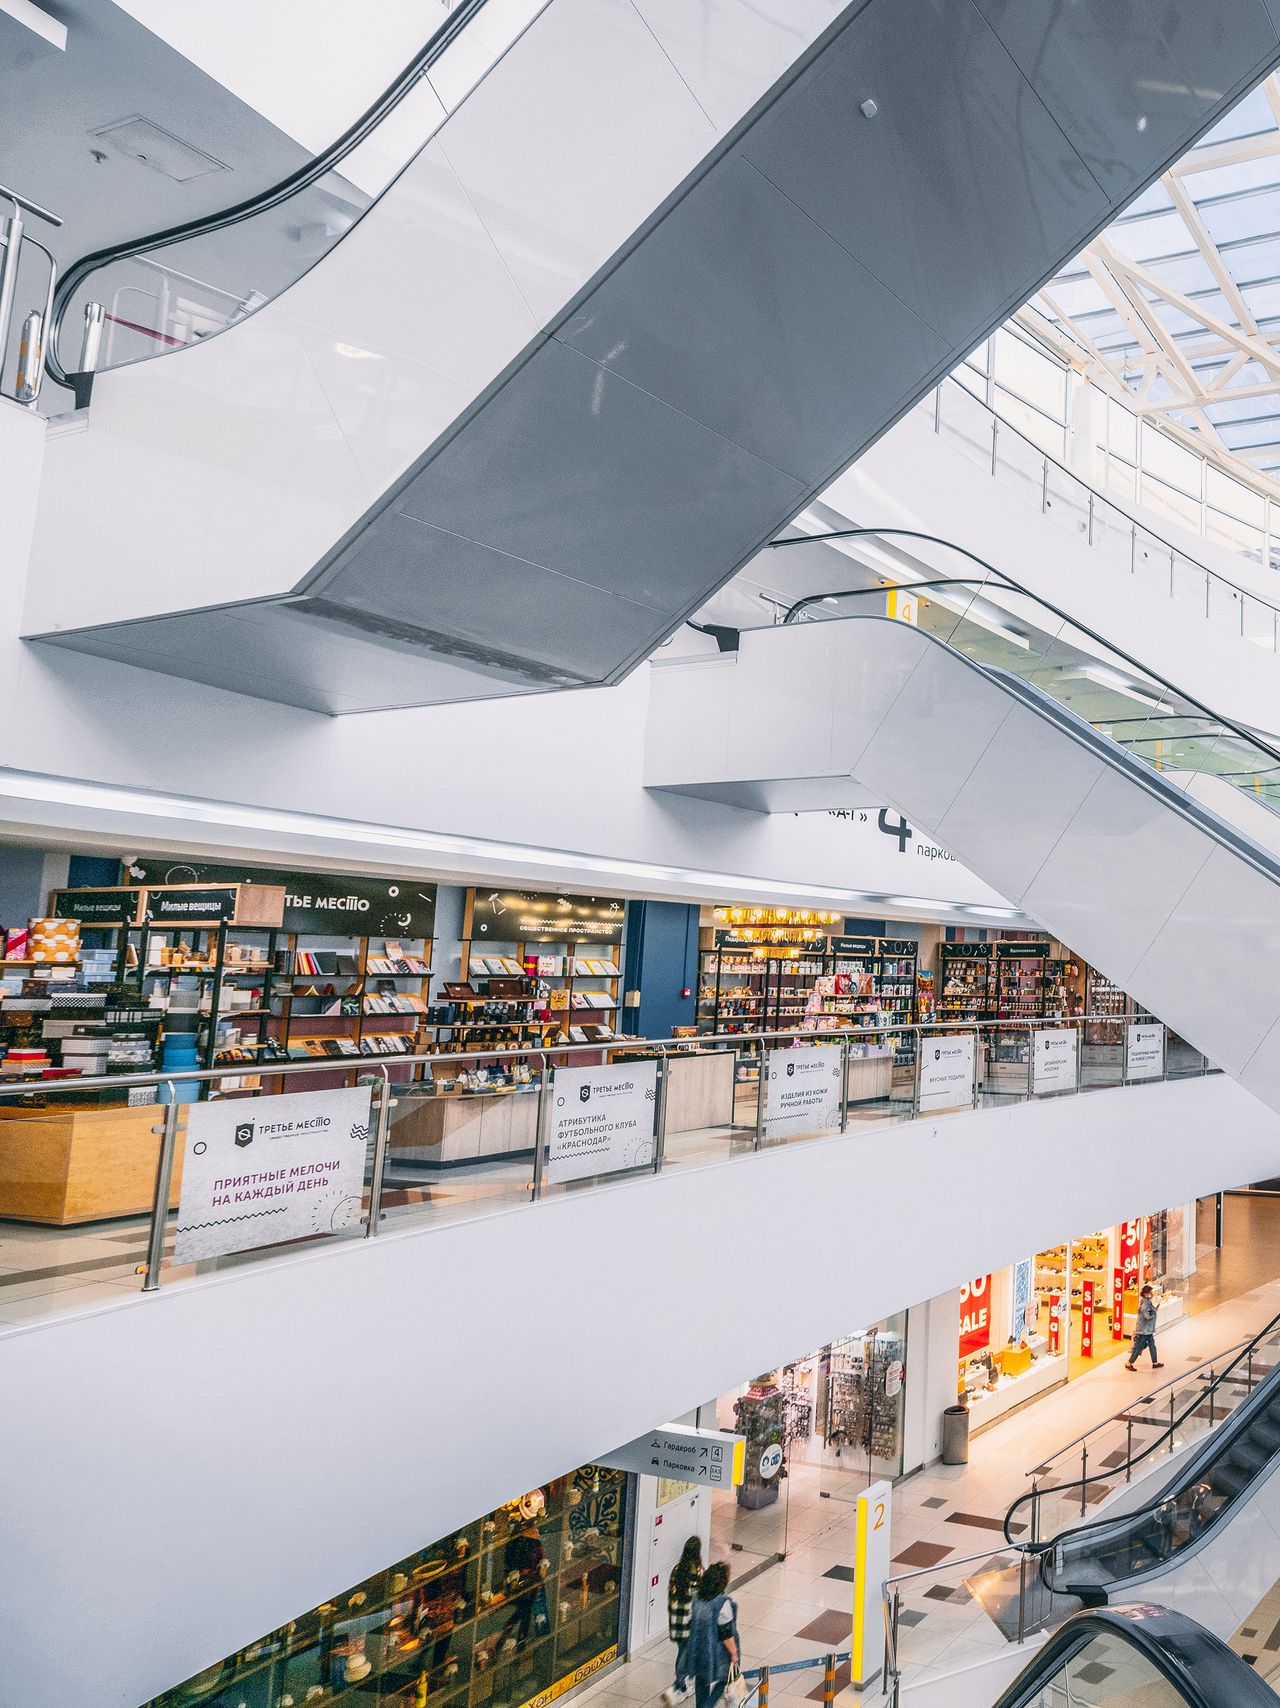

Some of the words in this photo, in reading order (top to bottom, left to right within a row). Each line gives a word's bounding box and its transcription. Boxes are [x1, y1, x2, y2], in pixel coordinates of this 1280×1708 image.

[902, 604, 912, 623] 4
[917, 844, 959, 861] парко
[73, 902, 95, 912] Милые
[161, 901, 188, 912] Милые
[188, 902, 221, 912] вещицы
[284, 894, 312, 908] ТЬЕ
[519, 925, 568, 933] ОБЩЕСТВЕННОЕ
[796, 1063, 810, 1071] ТРЕТЬЕ
[593, 1085, 612, 1094] ТРЕТЬЕ
[780, 1090, 805, 1100] ИЗДЕЛИЯ
[780, 1098, 802, 1109] РУЧНОЙ
[803, 1097, 823, 1105] РАБОТЫ
[259, 1122, 293, 1134] ТРЕТЬЕ
[558, 1114, 606, 1128] АТРИБУТИКА
[557, 1123, 614, 1139] ФУТБОЛЬНОГО
[615, 1120, 637, 1130] КЛУБА
[557, 1135, 611, 1150] «КРАСНОДАР»
[213, 1169, 287, 1191] ПРИЯТНЫЕ
[289, 1160, 341, 1178] МЕЛОЧИ
[212, 1196, 231, 1207] НА
[234, 1180, 294, 1203] КАЖДЫЙ
[296, 1177, 329, 1192] ДЕНЬ
[1114, 1277, 1122, 1331] sale
[1083, 1290, 1092, 1347] sale
[1050, 1305, 1059, 1350] sal
[663, 1441, 696, 1454] Гардероб
[714, 1448, 720, 1457] 4
[663, 1459, 695, 1473] Парковка
[874, 1503, 885, 1531] 2
